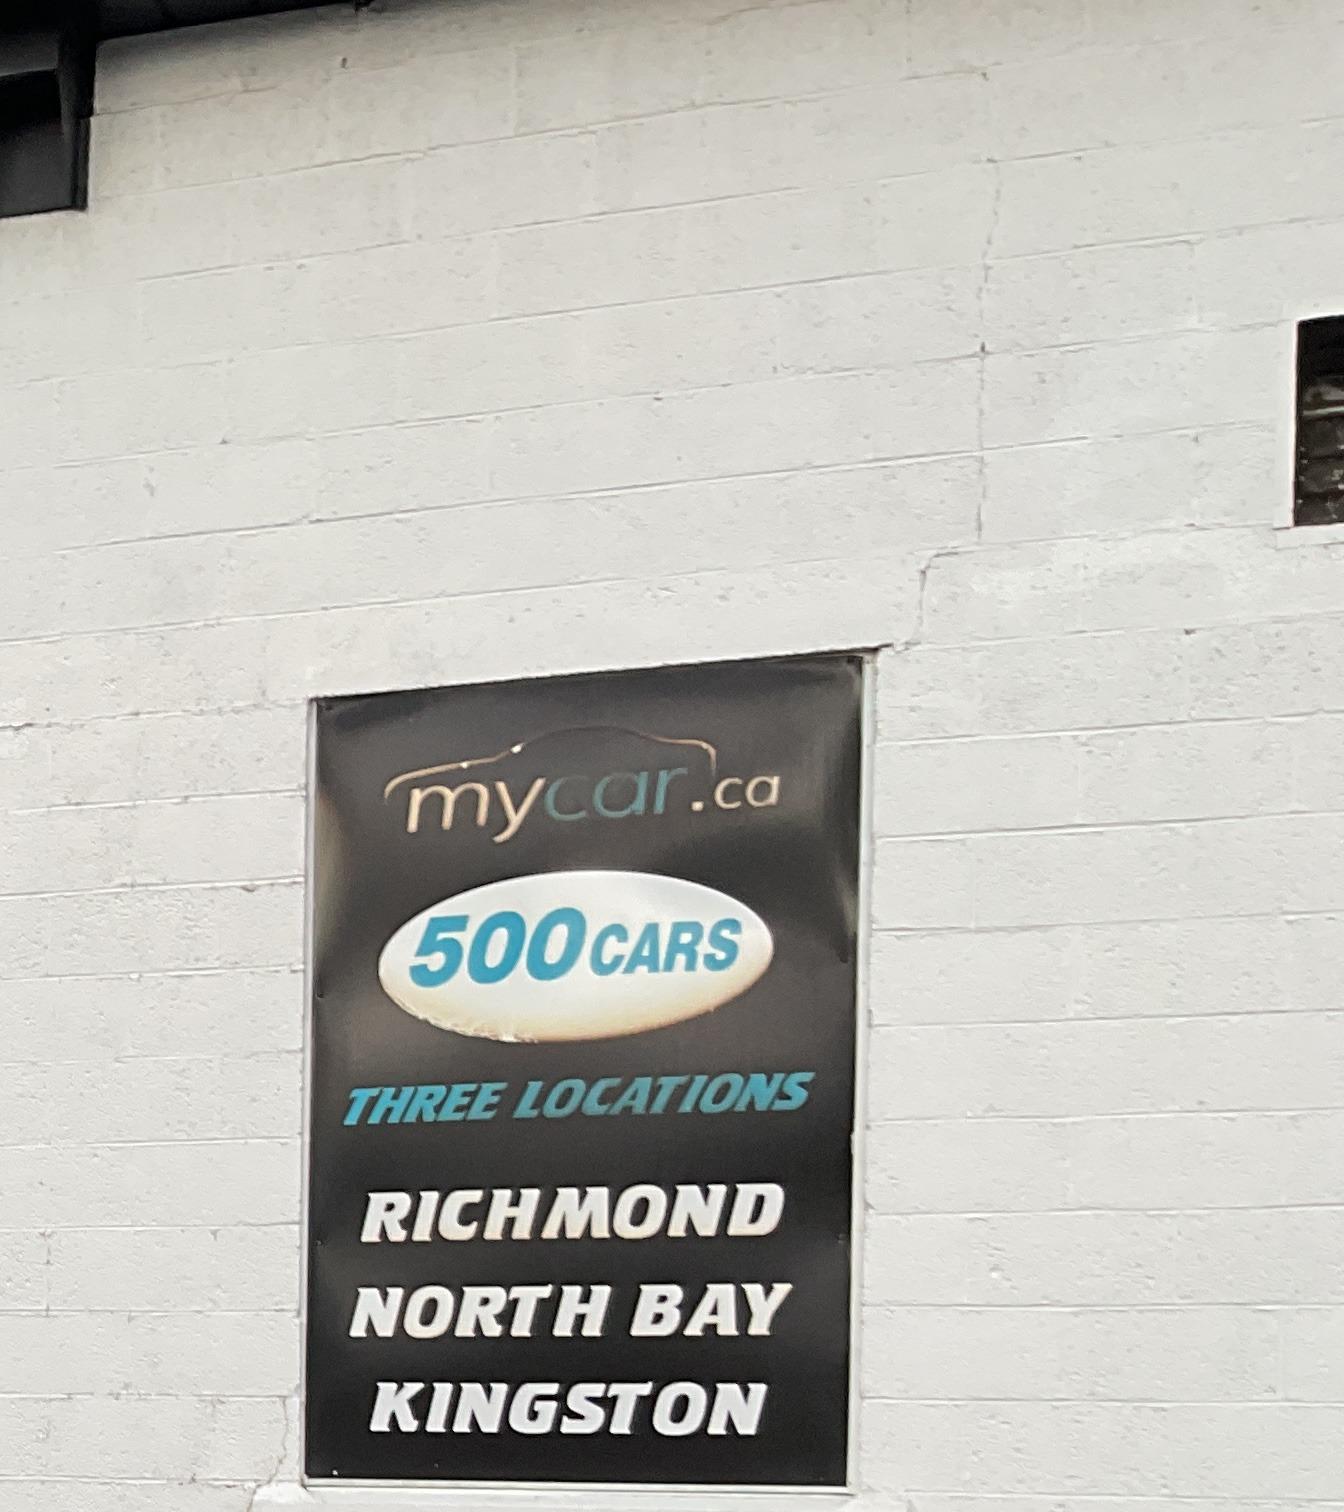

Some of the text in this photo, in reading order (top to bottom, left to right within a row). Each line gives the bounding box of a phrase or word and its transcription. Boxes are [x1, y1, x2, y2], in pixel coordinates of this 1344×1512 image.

[408, 907, 743, 989] 500 CARS
[343, 1071, 816, 1127] THREE LOCATIONS
[359, 1183, 786, 1244] RICHMOND
[348, 1282, 793, 1339] NORTH BAY
[368, 1380, 767, 1437] KINGSTON
